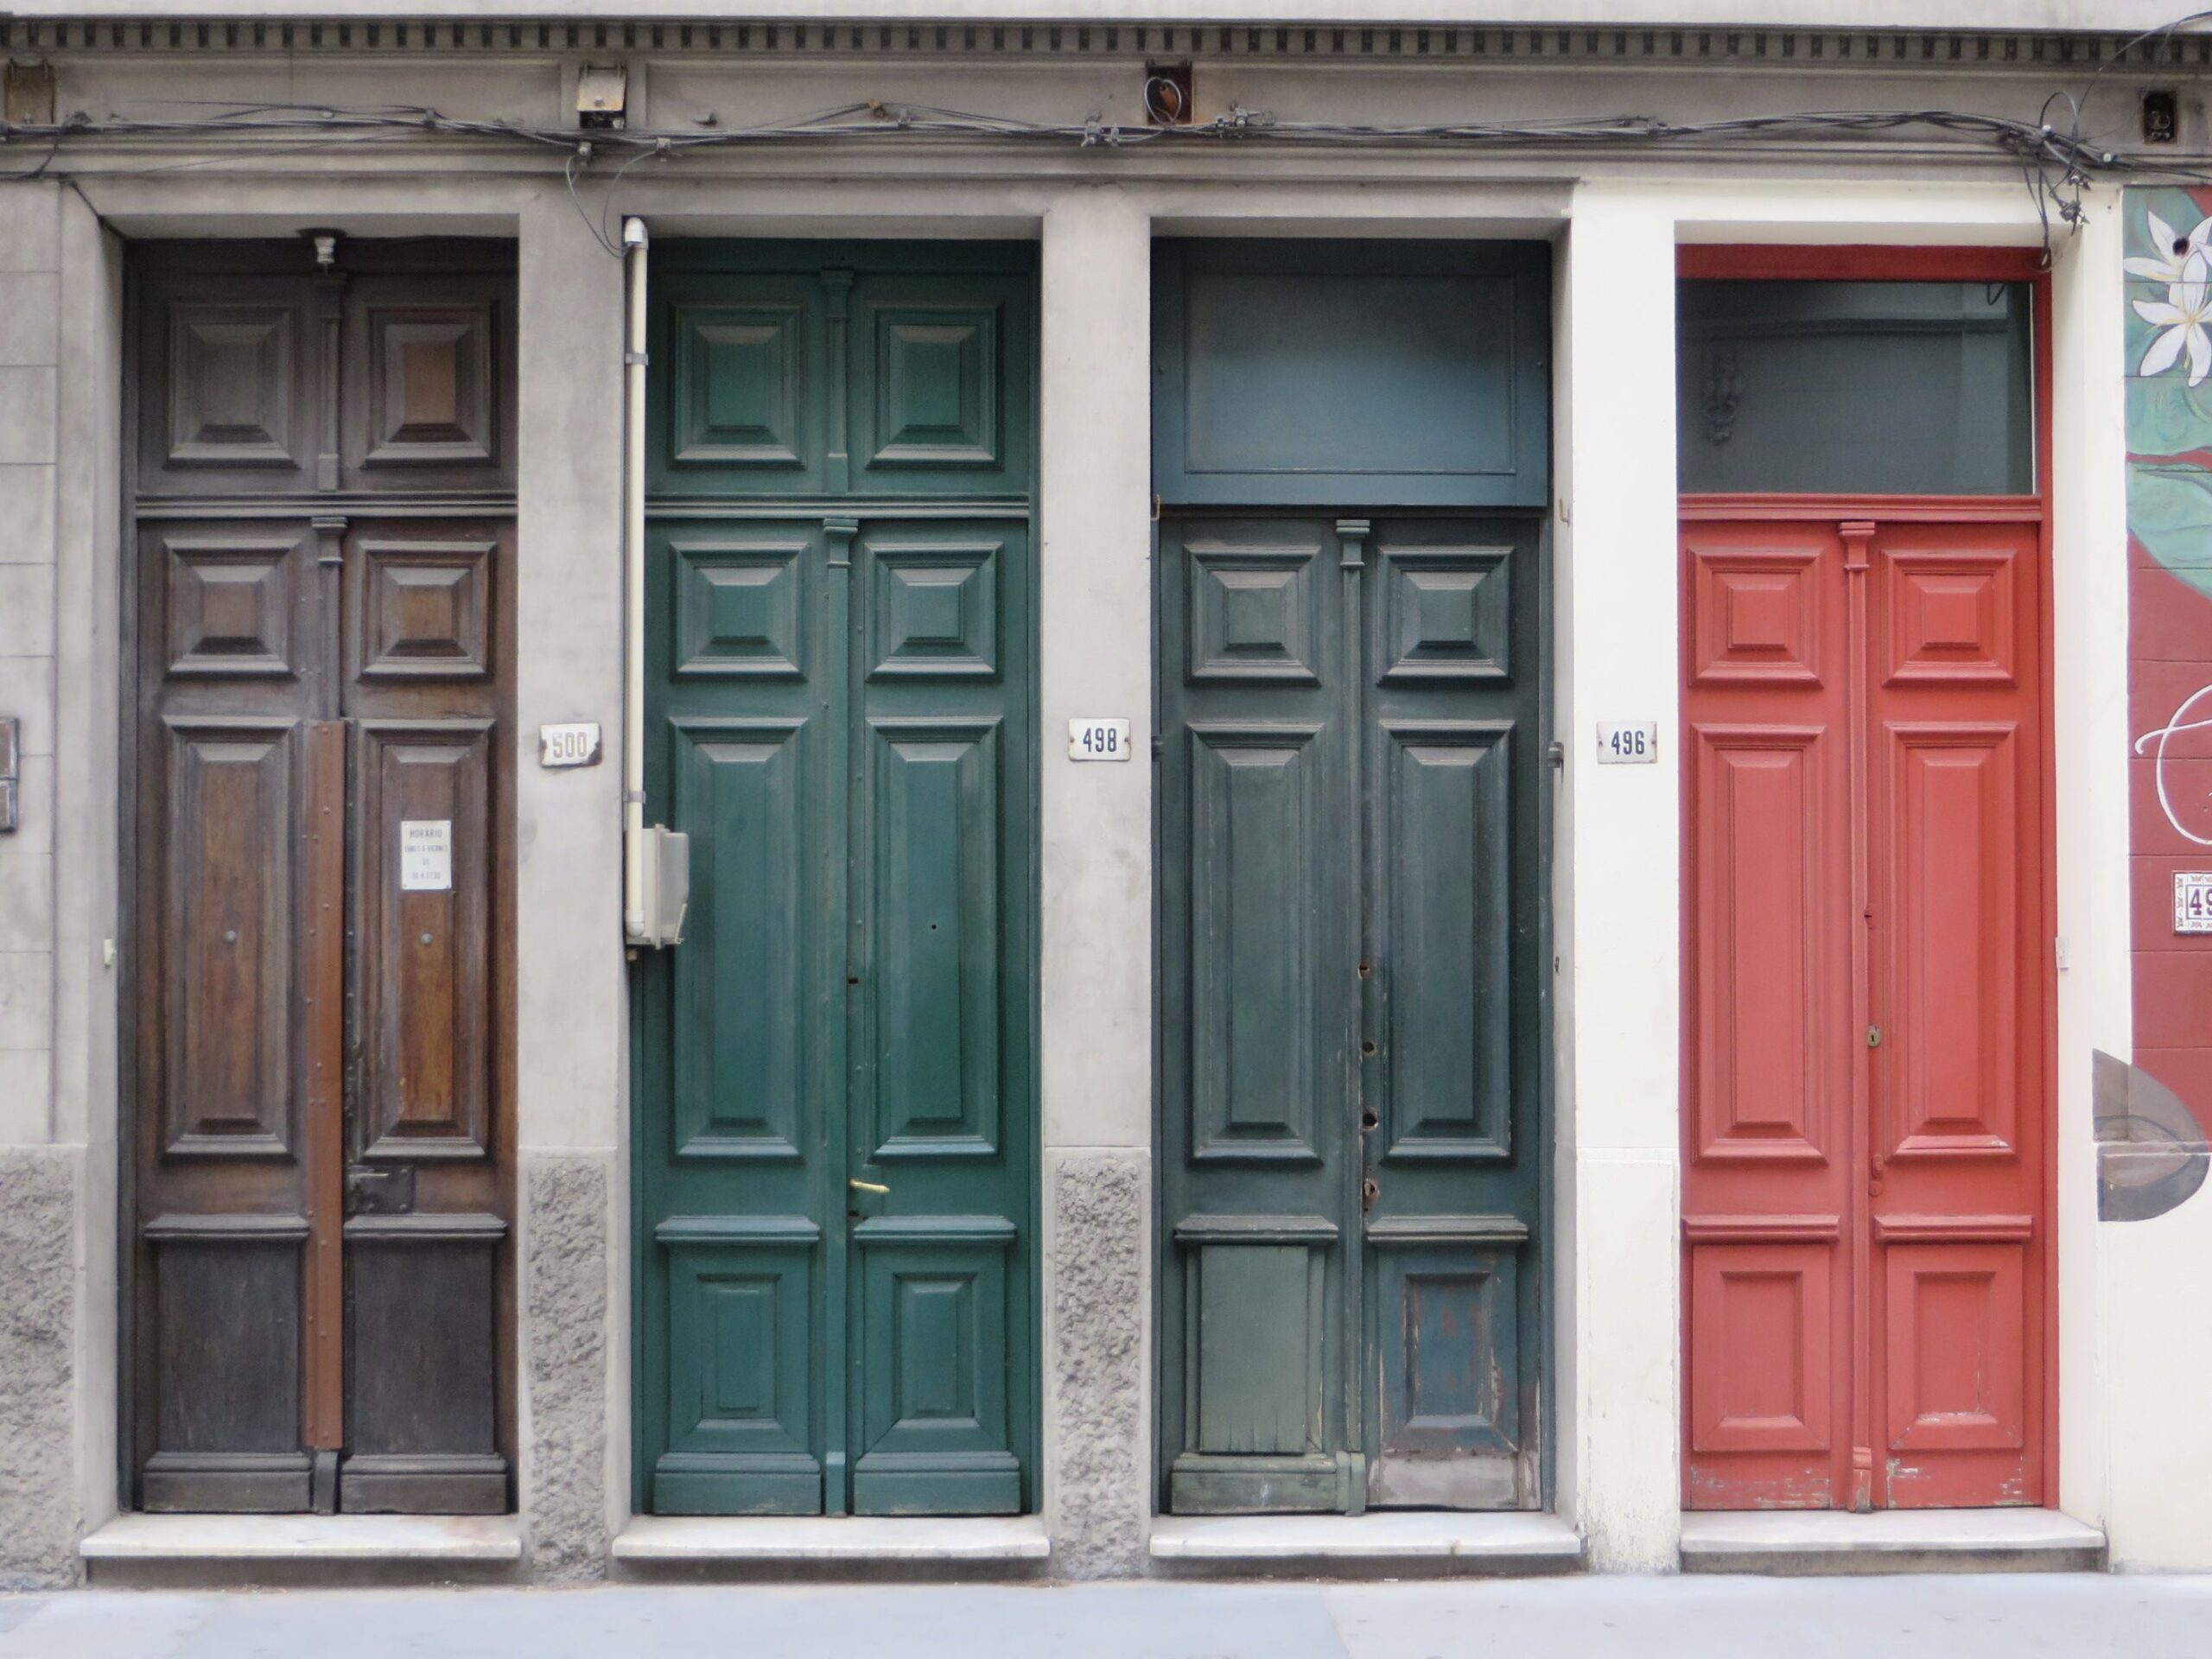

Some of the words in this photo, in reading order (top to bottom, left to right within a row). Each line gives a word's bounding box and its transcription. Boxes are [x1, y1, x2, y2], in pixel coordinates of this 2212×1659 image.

[553, 732, 588, 758] 500
[1083, 727, 1117, 753] 498
[1611, 730, 1645, 755] 496
